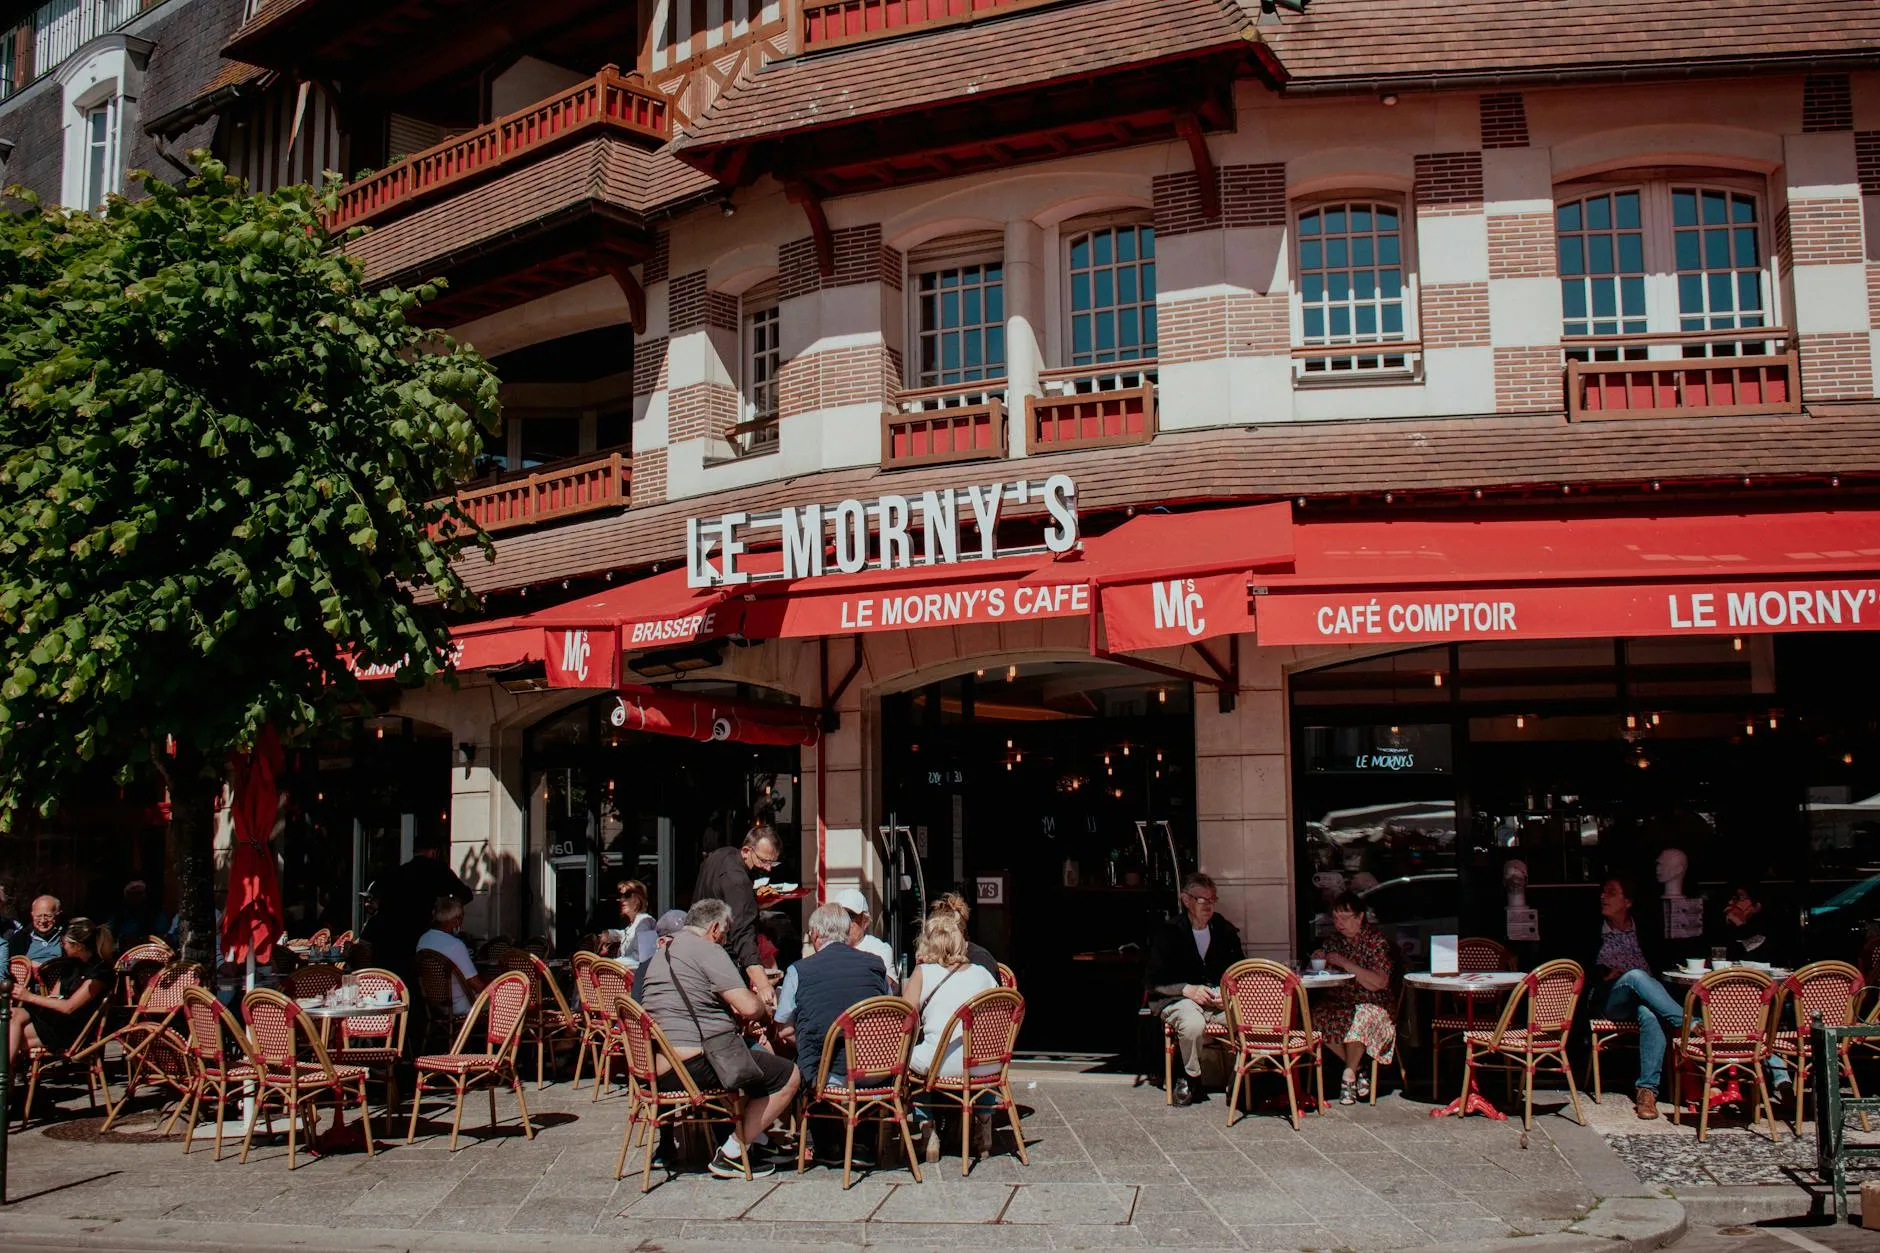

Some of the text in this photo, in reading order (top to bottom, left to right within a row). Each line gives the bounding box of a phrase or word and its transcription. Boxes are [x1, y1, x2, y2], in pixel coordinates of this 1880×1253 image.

[687, 474, 1079, 589] LE MORNY'S
[841, 599, 874, 628] LE
[881, 588, 1006, 625] MORNY'S
[1317, 598, 1518, 635] CAFÉ COMPTOIR
[1669, 593, 1718, 628] LE
[631, 613, 717, 643] BRASSERIE
[1356, 754, 1369, 768] LE
